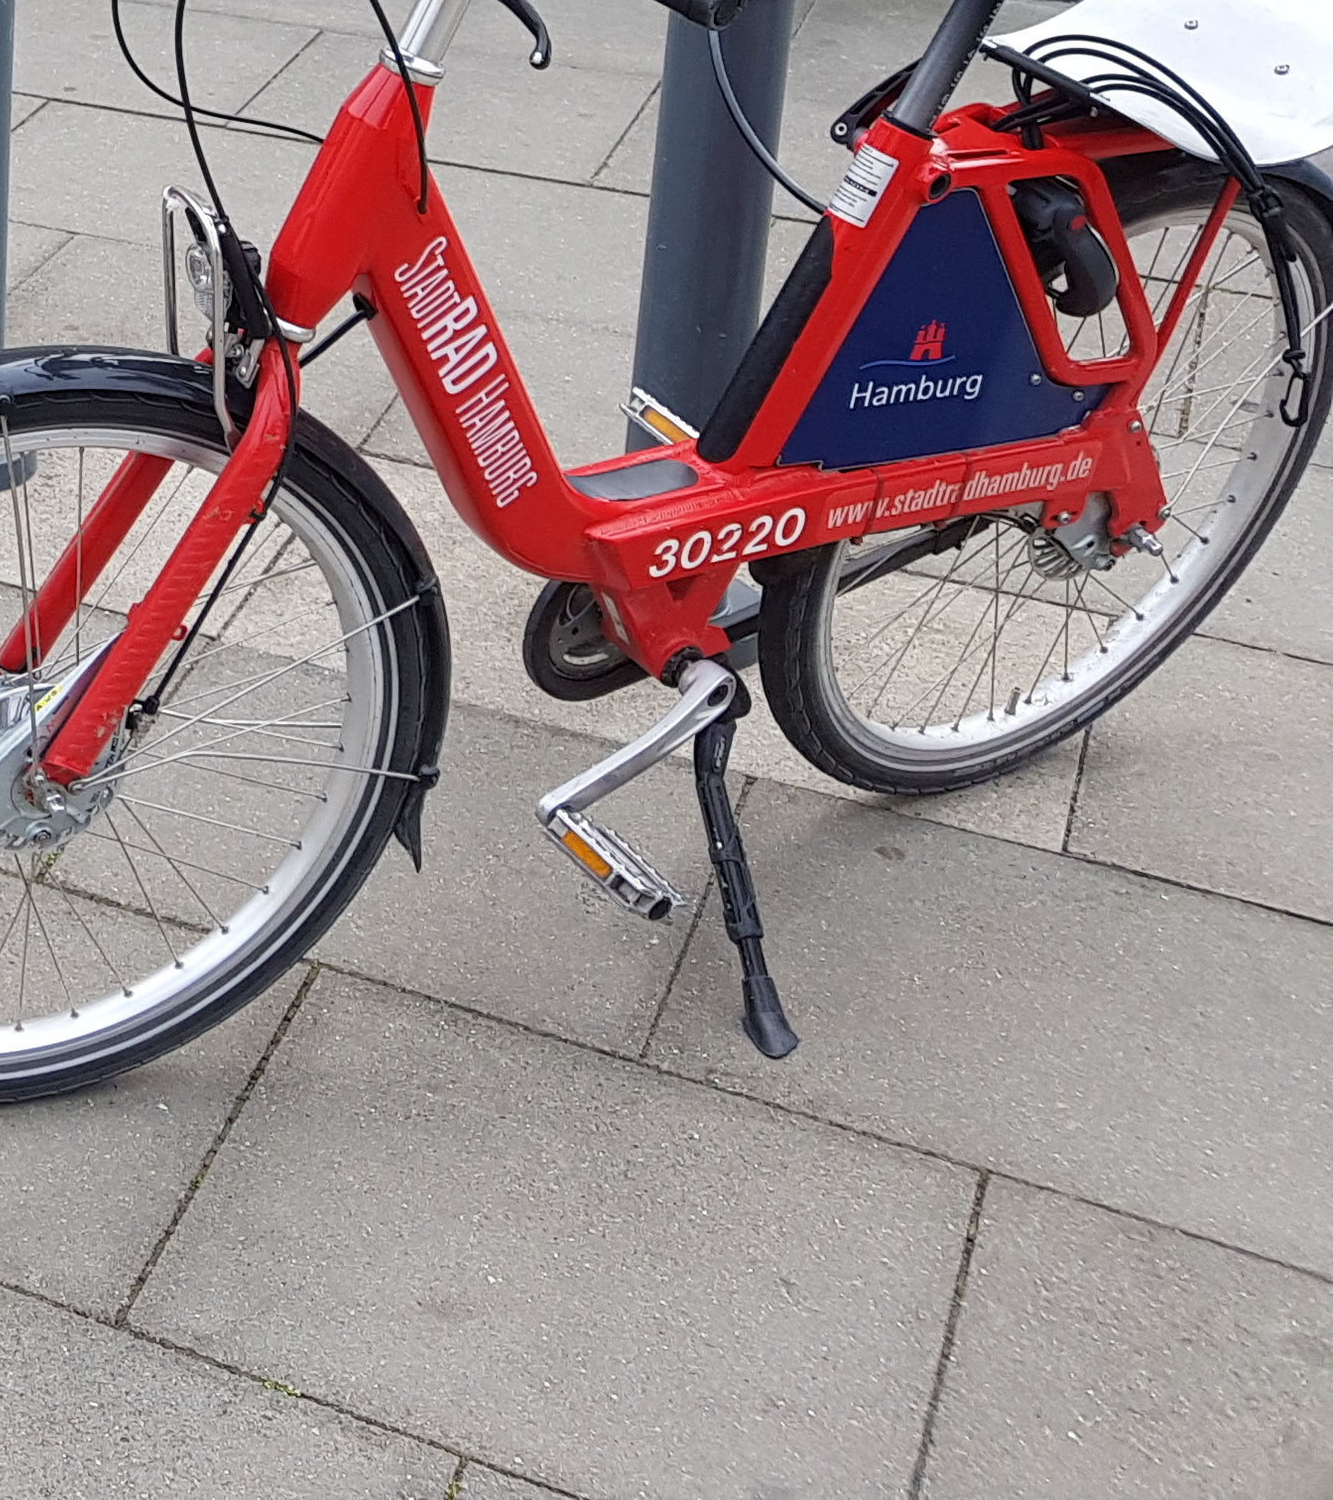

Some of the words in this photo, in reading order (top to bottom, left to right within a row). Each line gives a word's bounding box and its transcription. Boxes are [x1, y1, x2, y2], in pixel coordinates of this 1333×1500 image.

[849, 374, 983, 409] Hamburg
[455, 373, 538, 509] HAMBURG
[648, 507, 806, 579] 30220
